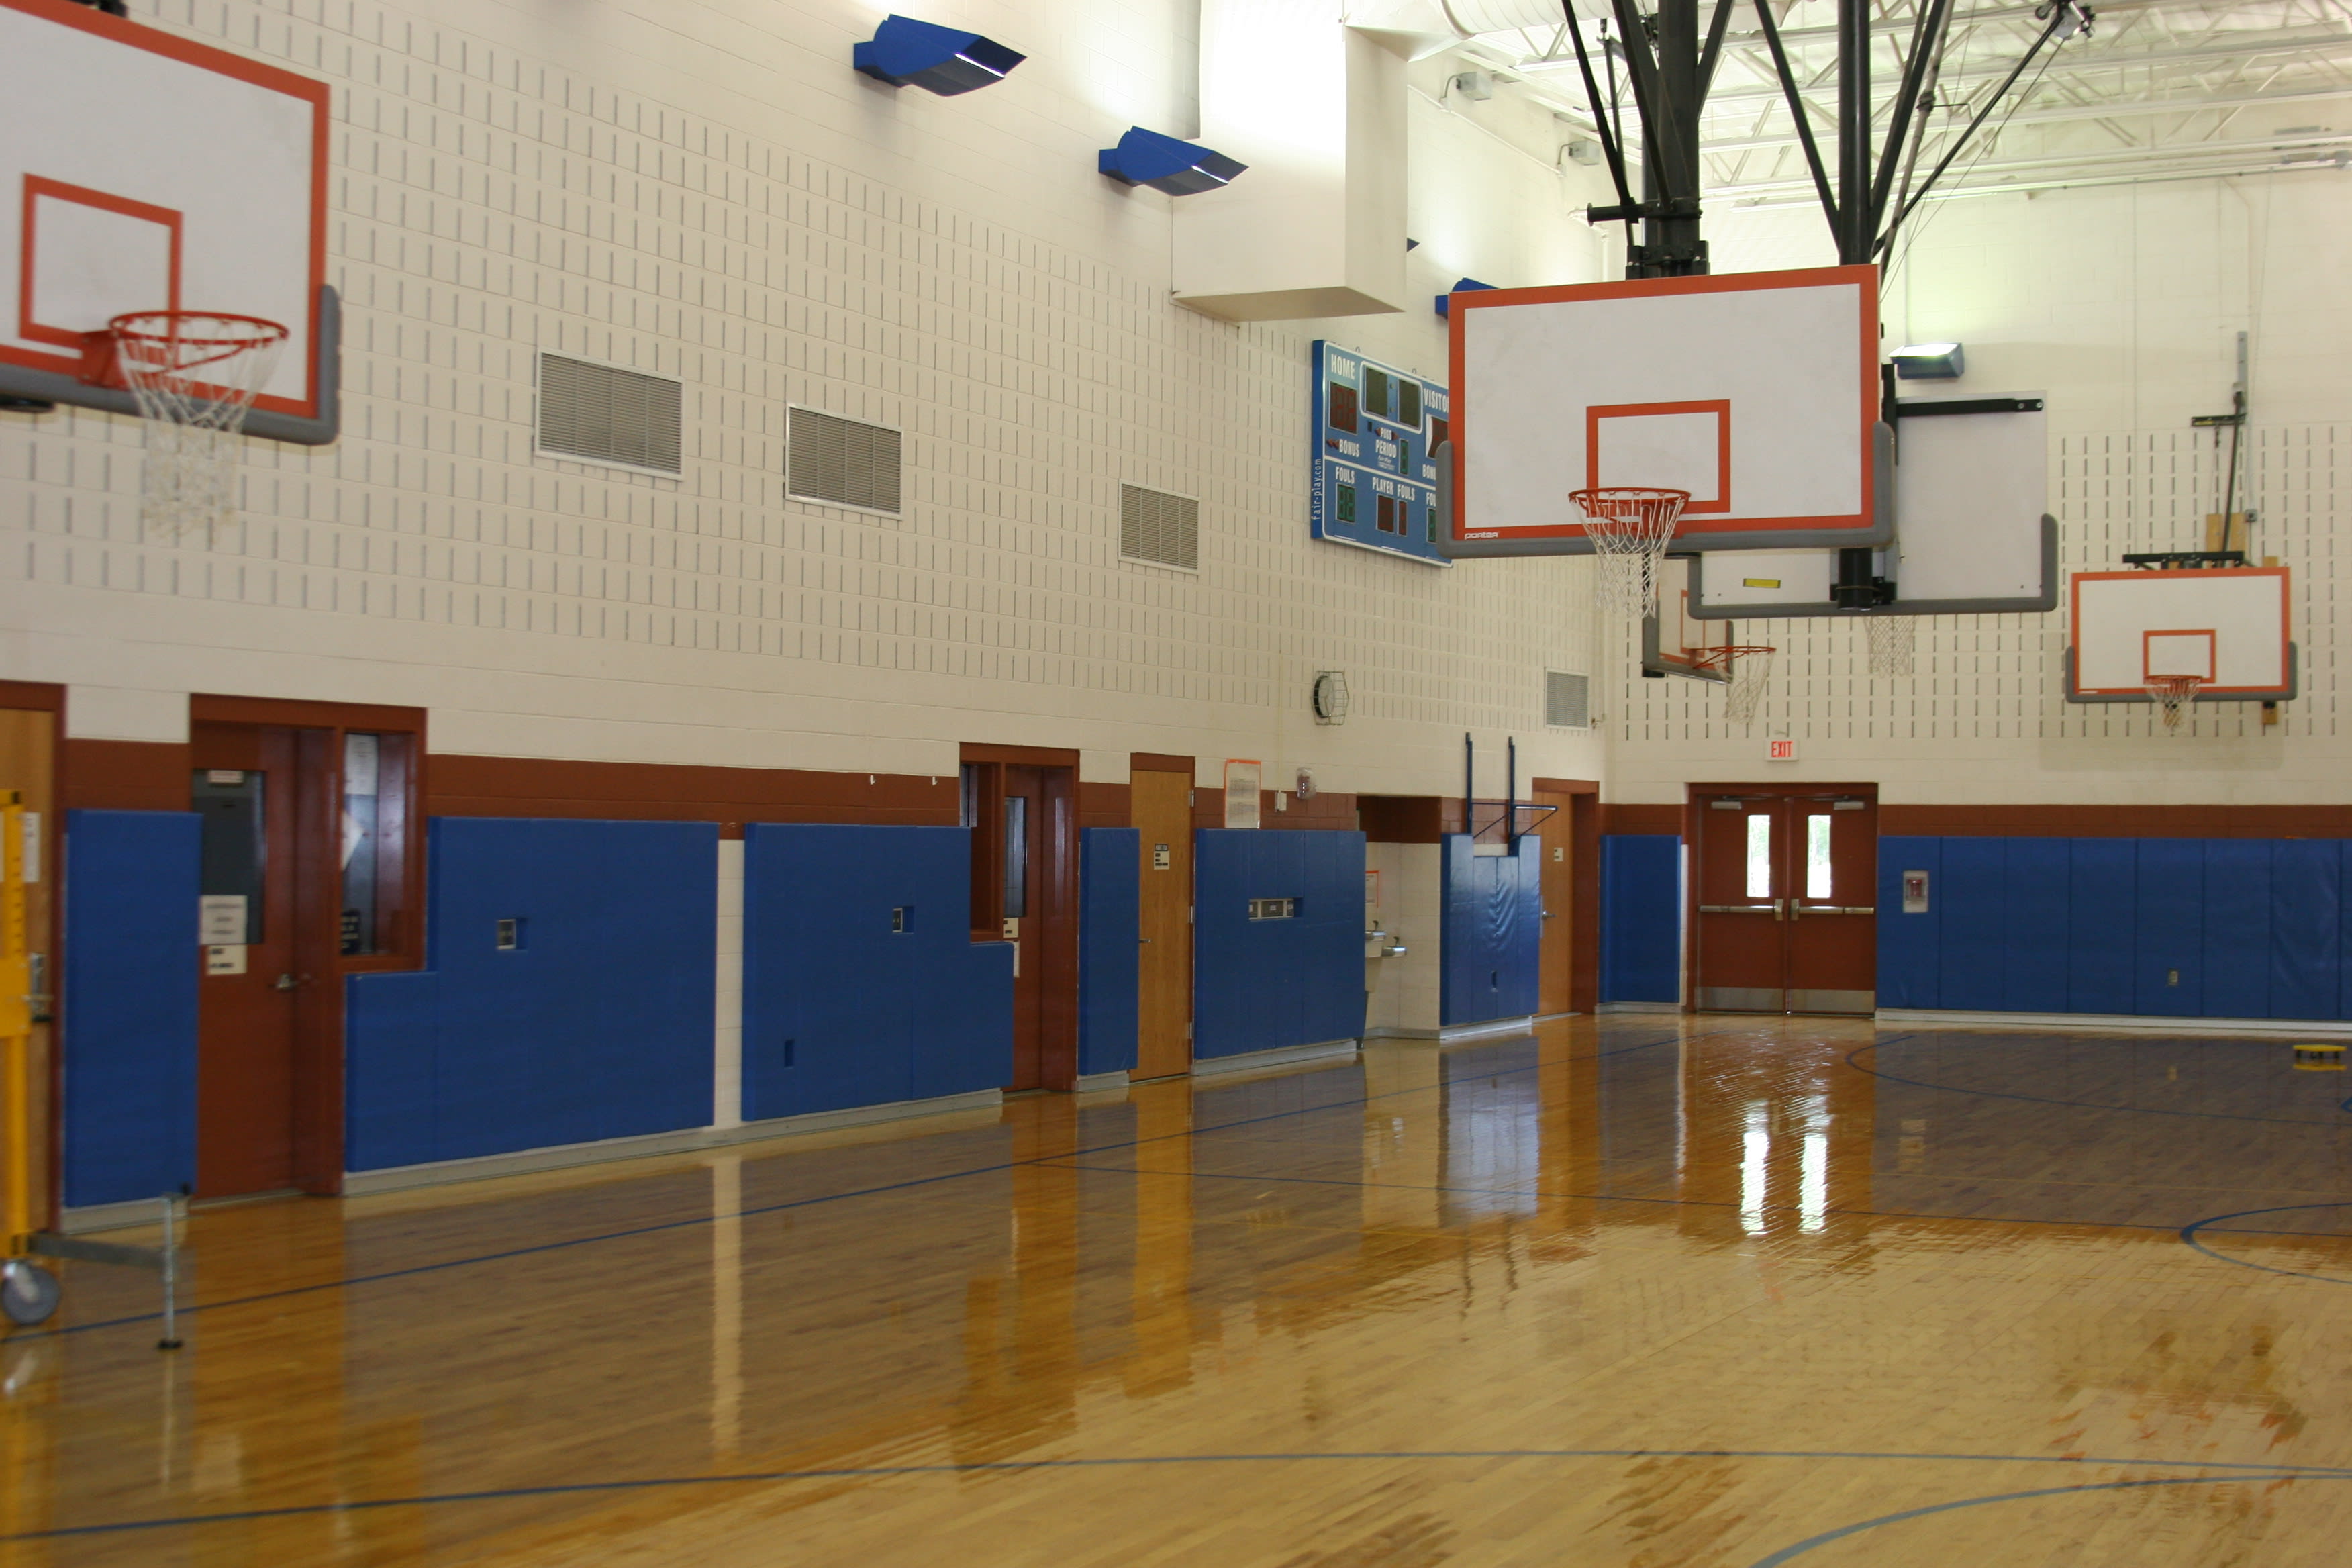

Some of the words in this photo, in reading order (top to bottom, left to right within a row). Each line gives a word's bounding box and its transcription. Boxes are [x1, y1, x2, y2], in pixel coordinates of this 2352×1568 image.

[1331, 354, 1355, 380] HOME
[1339, 439, 1359, 458] BONUS
[1375, 439, 1397, 458] PERIOD
[1336, 466, 1355, 484] FOULS
[1311, 458, 1322, 520] fair-play.com
[1373, 477, 1394, 495] PLAYER
[1397, 484, 1415, 501] FOULS
[1426, 492, 1436, 507] FOU
[1771, 741, 1794, 757] EXIT
